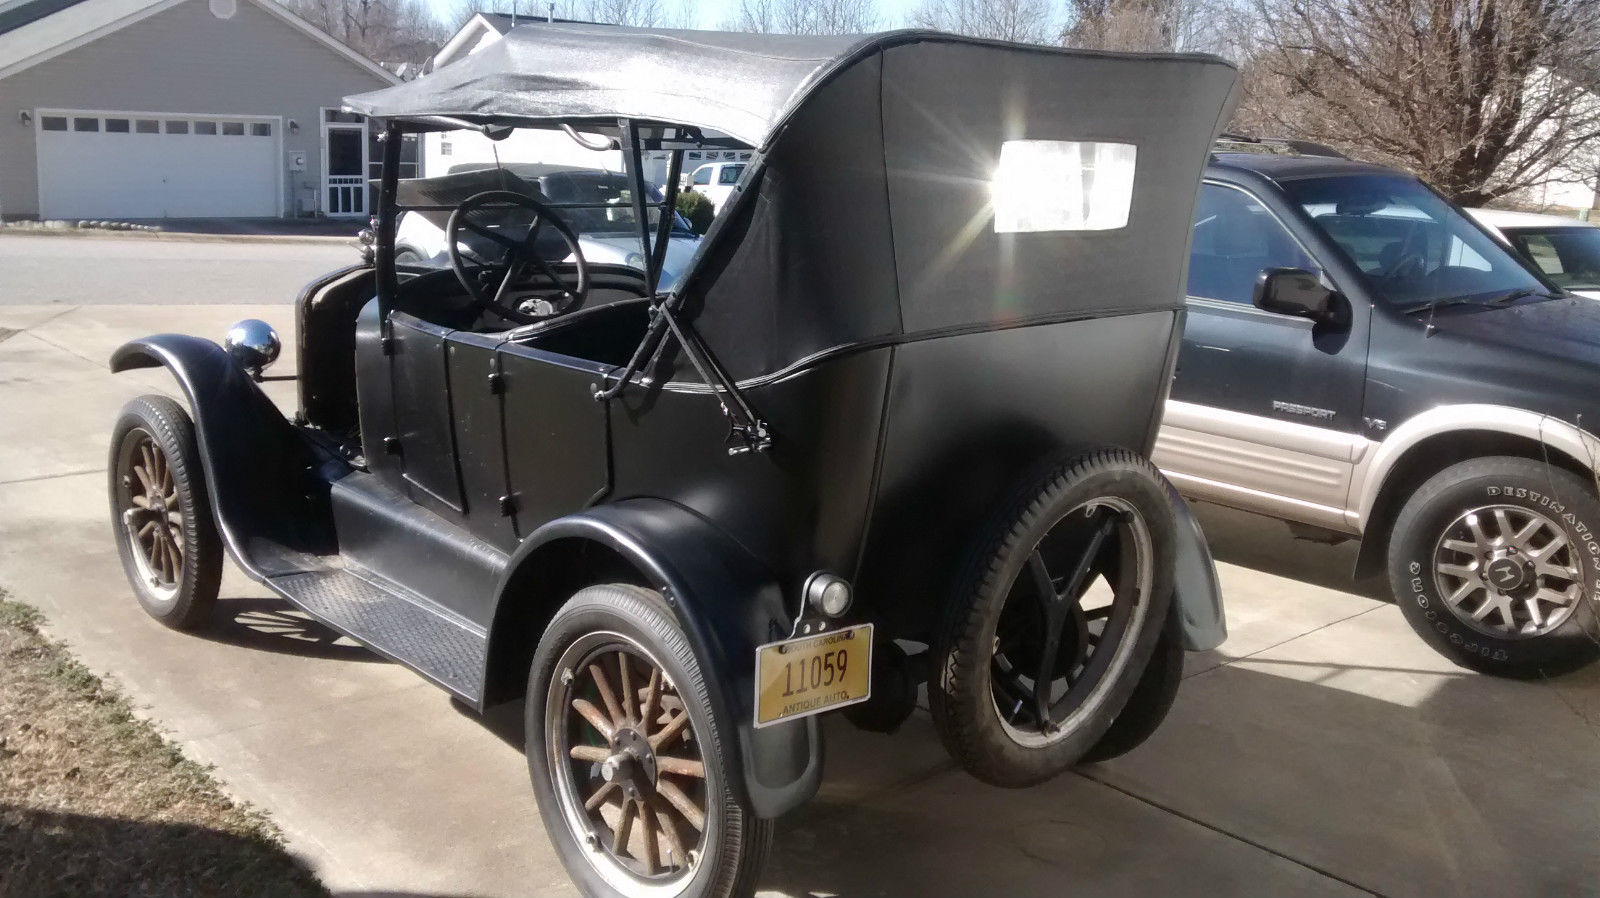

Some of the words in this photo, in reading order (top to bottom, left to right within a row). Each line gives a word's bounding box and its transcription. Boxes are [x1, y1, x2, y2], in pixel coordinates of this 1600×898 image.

[1273, 400, 1336, 420] PASSPORT
[782, 649, 848, 697] 11059
[783, 695, 822, 714] ANTIQUE
[824, 690, 847, 704] AUTO
